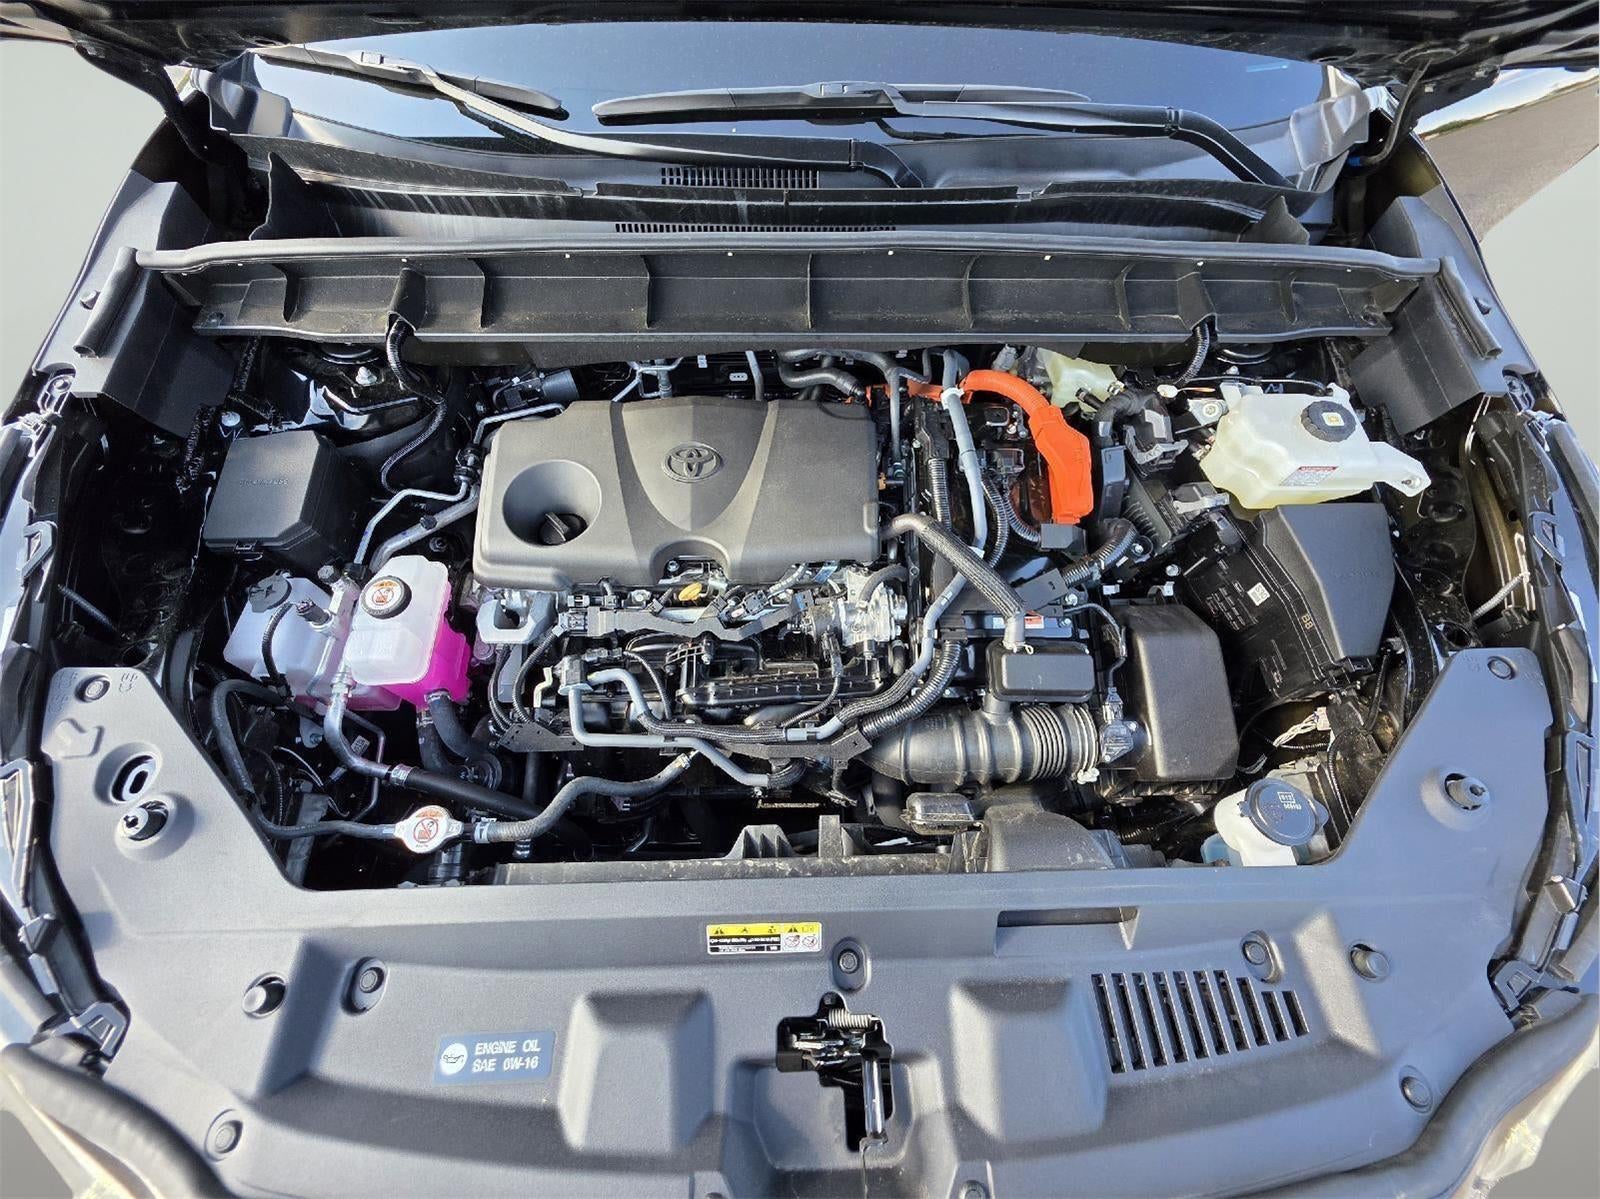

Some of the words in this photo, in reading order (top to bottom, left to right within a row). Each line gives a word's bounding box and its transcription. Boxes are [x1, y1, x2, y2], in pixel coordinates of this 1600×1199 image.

[475, 1041, 517, 1055] ENGINE
[522, 1039, 541, 1053] OIL
[472, 1059, 497, 1073] SAE
